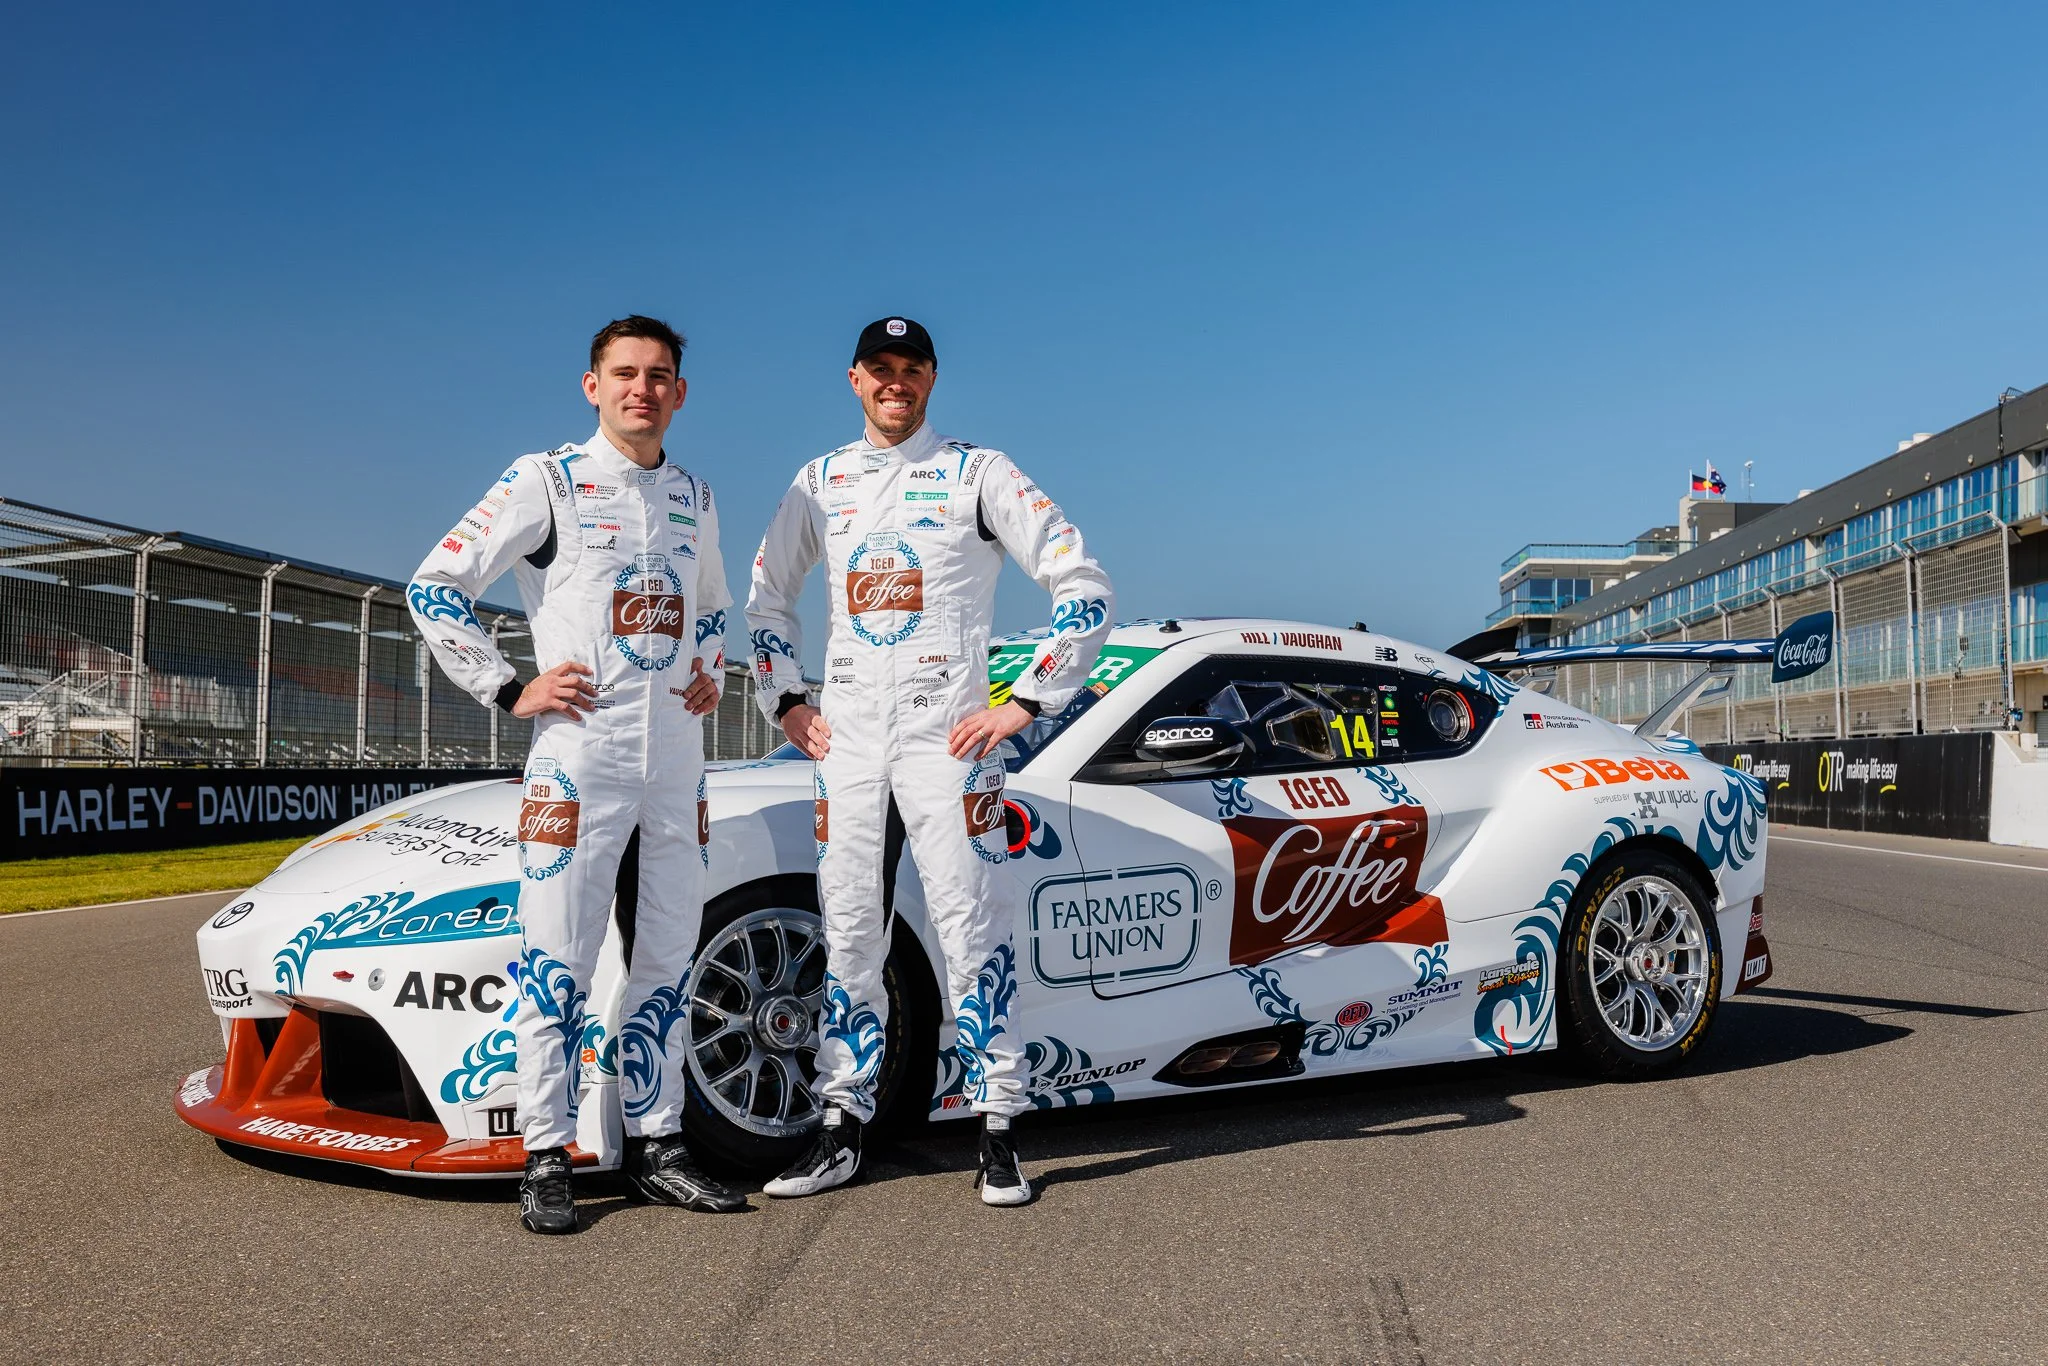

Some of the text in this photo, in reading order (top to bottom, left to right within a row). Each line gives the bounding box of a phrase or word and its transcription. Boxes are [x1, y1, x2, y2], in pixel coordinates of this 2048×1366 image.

[544, 461, 567, 498] sparco
[442, 538, 463, 554] 3M
[871, 557, 894, 570] ICED
[853, 573, 915, 610] Coffee
[620, 596, 680, 633] Coffee
[1240, 632, 1271, 645] HILL
[1280, 632, 1343, 651] VAUGHAN
[1778, 634, 1828, 669] Coca-Cola
[919, 655, 948, 664] C.HILL
[1145, 727, 1214, 745] sparco
[1331, 714, 1375, 758] 14
[1546, 721, 1579, 729] Australia
[1580, 757, 1690, 785] Beta
[1754, 763, 1770, 781] making
[1770, 760, 1778, 778] life
[1778, 764, 1790, 782] easy
[1819, 751, 1897, 792] OTR making life easy
[531, 784, 551, 798] ICED
[1278, 776, 1351, 811] ICED
[386, 813, 517, 848] Automotive
[356, 831, 500, 866] SUPERSTORE
[1253, 818, 1418, 944] Coffee
[1050, 888, 1183, 930] FARMERS
[1071, 922, 1165, 961] UNION
[1480, 960, 1540, 981] Lansvale
[1747, 957, 1766, 977] UNIT
[204, 968, 249, 997] TRG
[1388, 980, 1463, 1005] SUMMIT
[211, 996, 253, 1011] transport
[1341, 1004, 1368, 1023] PFD
[1055, 1057, 1147, 1088] DUNLOP
